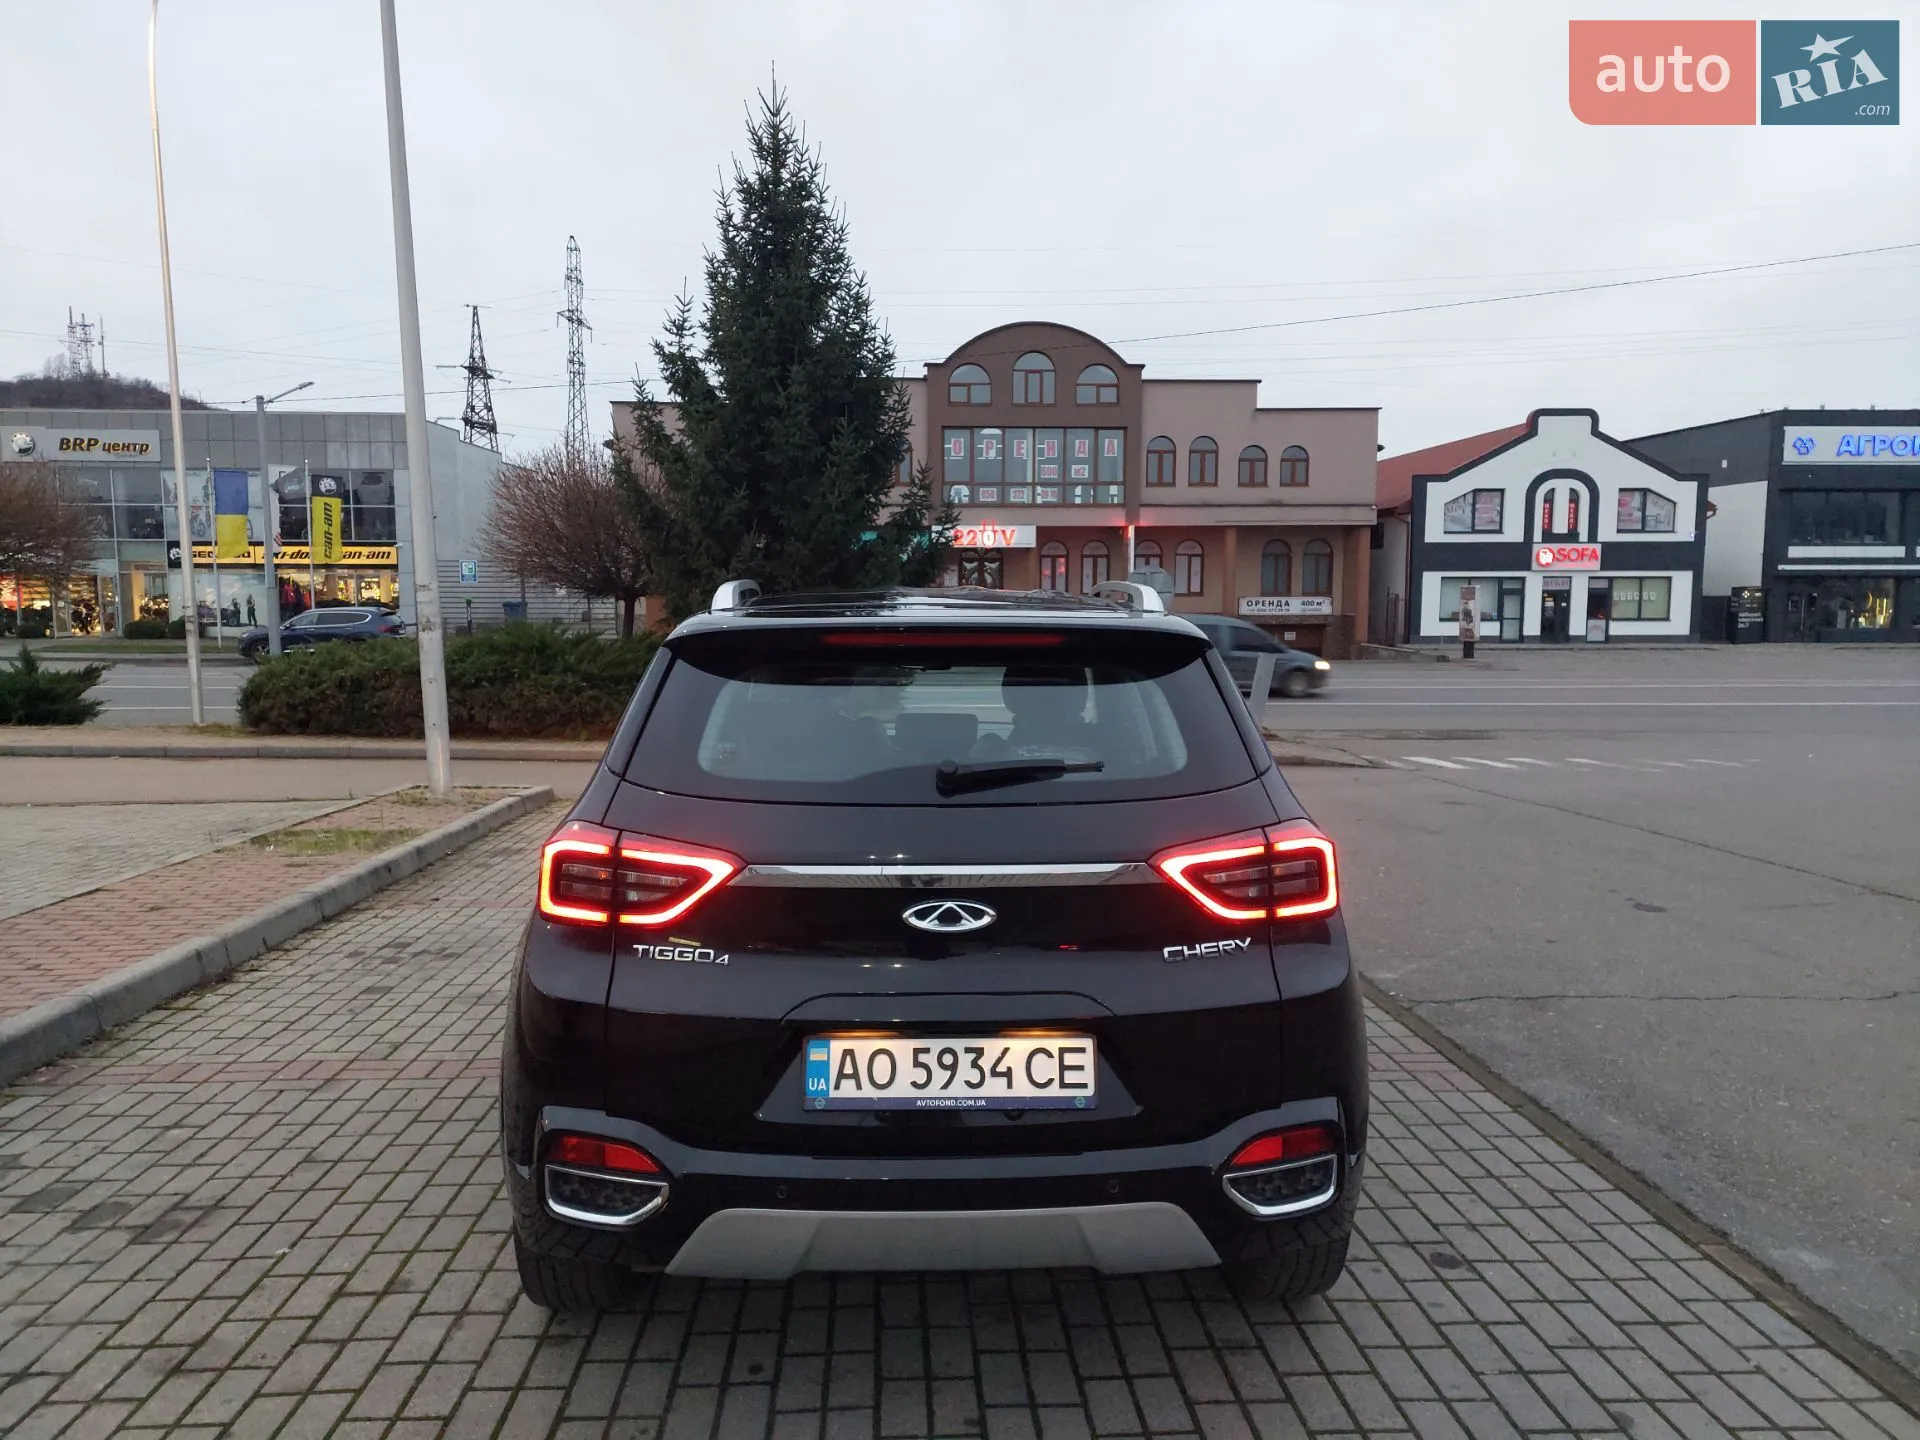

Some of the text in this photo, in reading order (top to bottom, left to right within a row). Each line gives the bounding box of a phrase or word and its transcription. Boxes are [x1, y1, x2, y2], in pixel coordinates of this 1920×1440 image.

[59, 437, 150, 455] BRP центр
[324, 502, 333, 558] can-am
[342, 551, 391, 559] an-am
[1556, 547, 1599, 562] SOFA
[1246, 600, 1290, 608] ОРЕНДА
[632, 944, 729, 966] TIGGO 4
[1163, 937, 1251, 962] CHERY
[833, 1046, 1089, 1091] AO 5934 CE
[808, 1077, 828, 1091] UA
[916, 1099, 986, 1107] AVTOFOND.COM.UA
